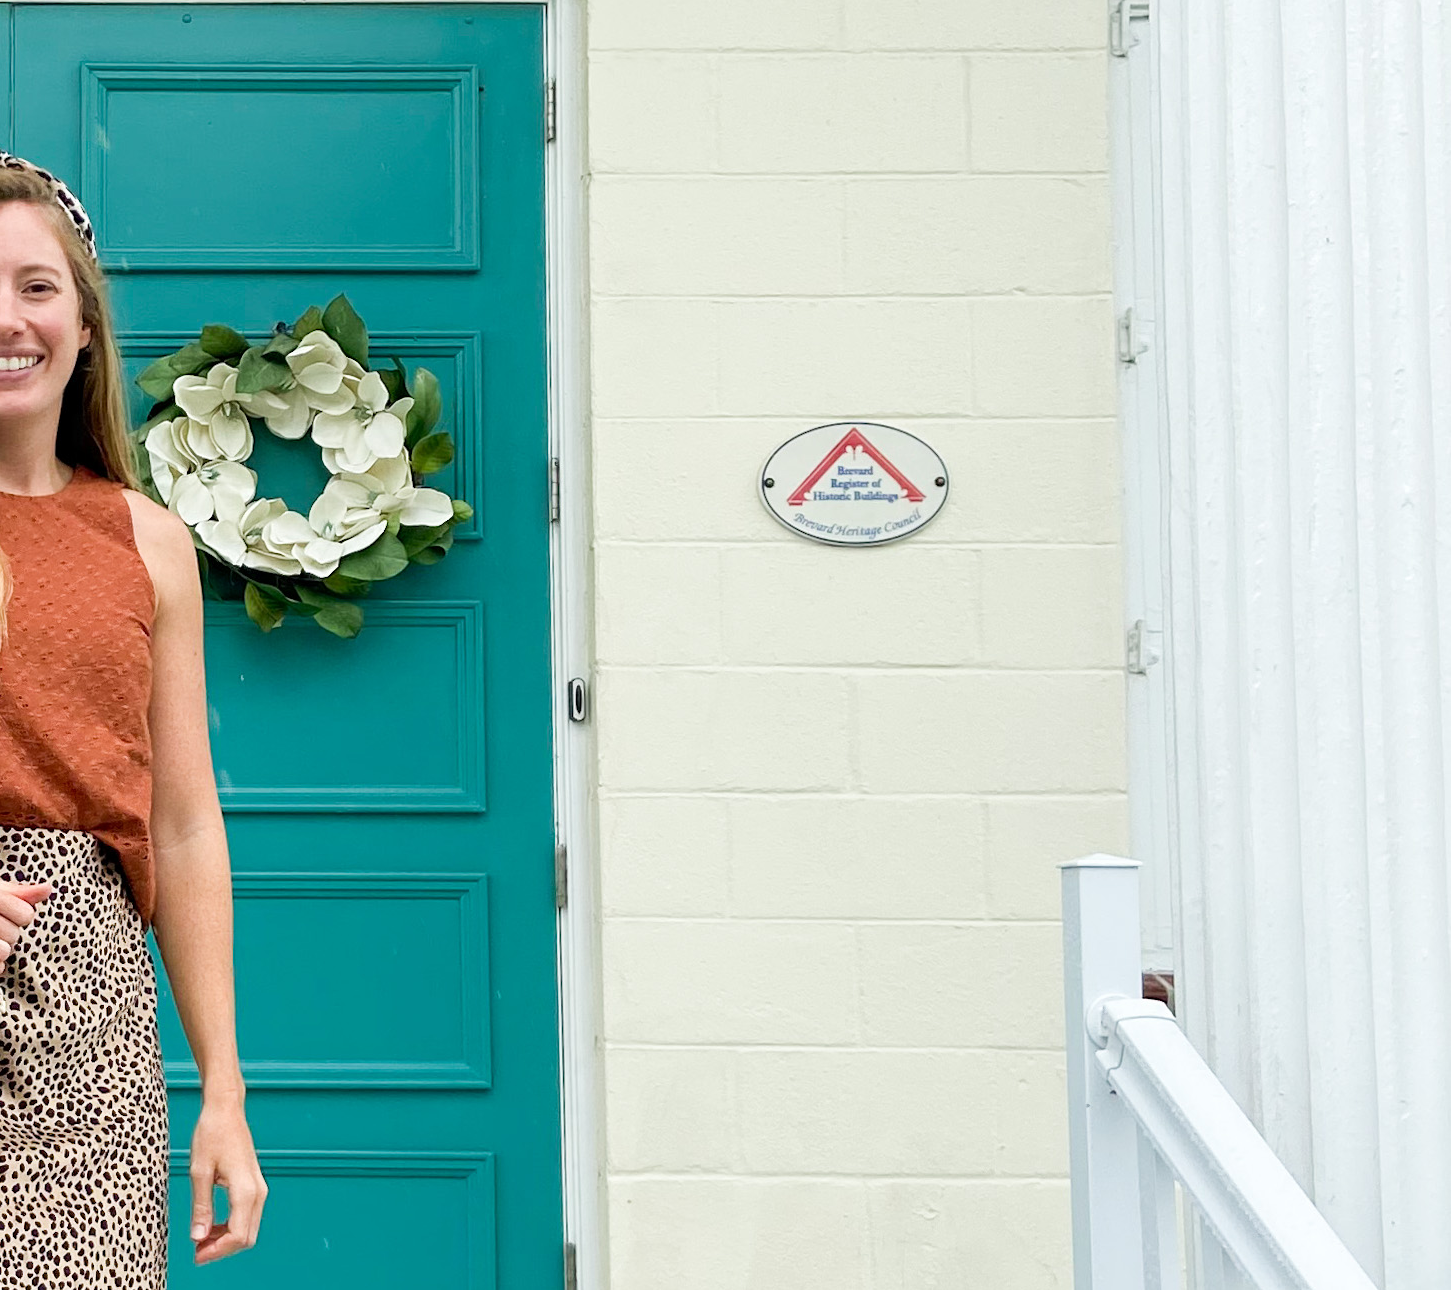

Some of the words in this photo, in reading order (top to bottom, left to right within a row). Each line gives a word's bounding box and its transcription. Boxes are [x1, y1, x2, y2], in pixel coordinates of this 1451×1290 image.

[837, 466, 874, 476] Brevard
[831, 479, 869, 489] Register
[871, 479, 881, 488] of
[813, 491, 851, 501] Historic
[854, 491, 899, 503] Buildings
[794, 513, 836, 533] Brevard
[835, 525, 882, 540] Heritage
[884, 508, 922, 533] Council
